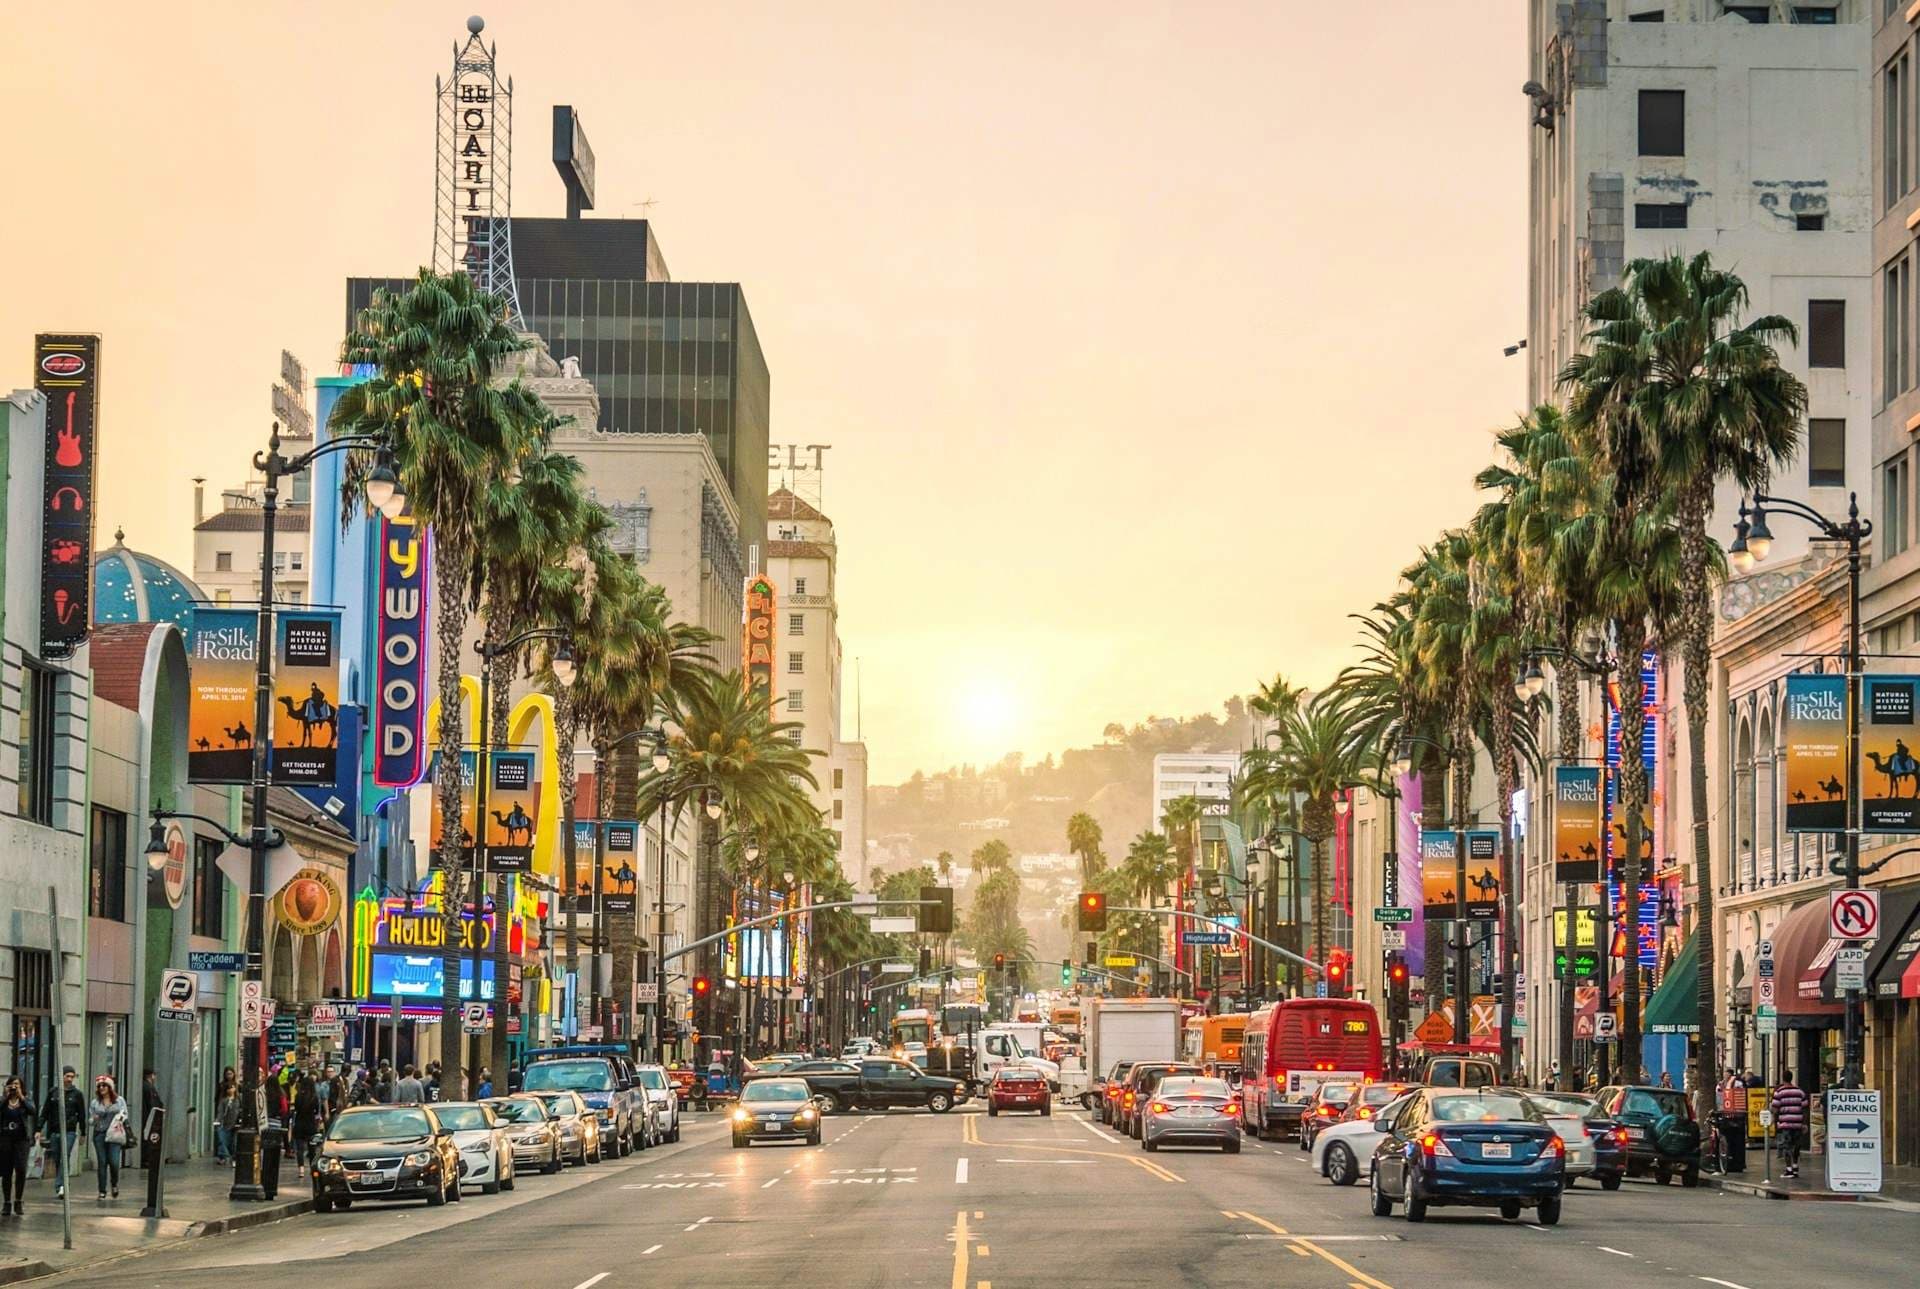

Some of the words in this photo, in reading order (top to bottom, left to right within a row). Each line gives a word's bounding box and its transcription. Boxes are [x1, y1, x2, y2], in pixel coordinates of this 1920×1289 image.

[204, 631, 218, 640] The
[217, 628, 249, 647] Silk
[203, 640, 254, 661] Road
[1797, 694, 1808, 702] The
[1808, 691, 1837, 708] Silk
[1796, 702, 1844, 721] Road
[1572, 780, 1593, 792] Silk
[1563, 787, 1597, 801] Road
[1435, 840, 1451, 850] Silk
[1428, 847, 1455, 858] Road
[315, 872, 336, 896] KING
[286, 919, 305, 934] Since
[309, 921, 327, 933] 1989
[1186, 934, 1215, 943] Highland
[191, 953, 234, 963] McCadden
[1838, 951, 1863, 959] LAPD
[165, 1011, 178, 1019] PAY
[179, 1012, 198, 1021] HERE
[314, 1006, 336, 1018] ATM
[1321, 1024, 1331, 1033] M
[1347, 1021, 1365, 1031] 780
[1831, 1094, 1877, 1102] PUBLIC
[1830, 1104, 1877, 1112] PARKING
[1834, 1141, 1846, 1149] PARK
[1848, 1141, 1860, 1149] LOCK
[1862, 1141, 1875, 1149] WALK
